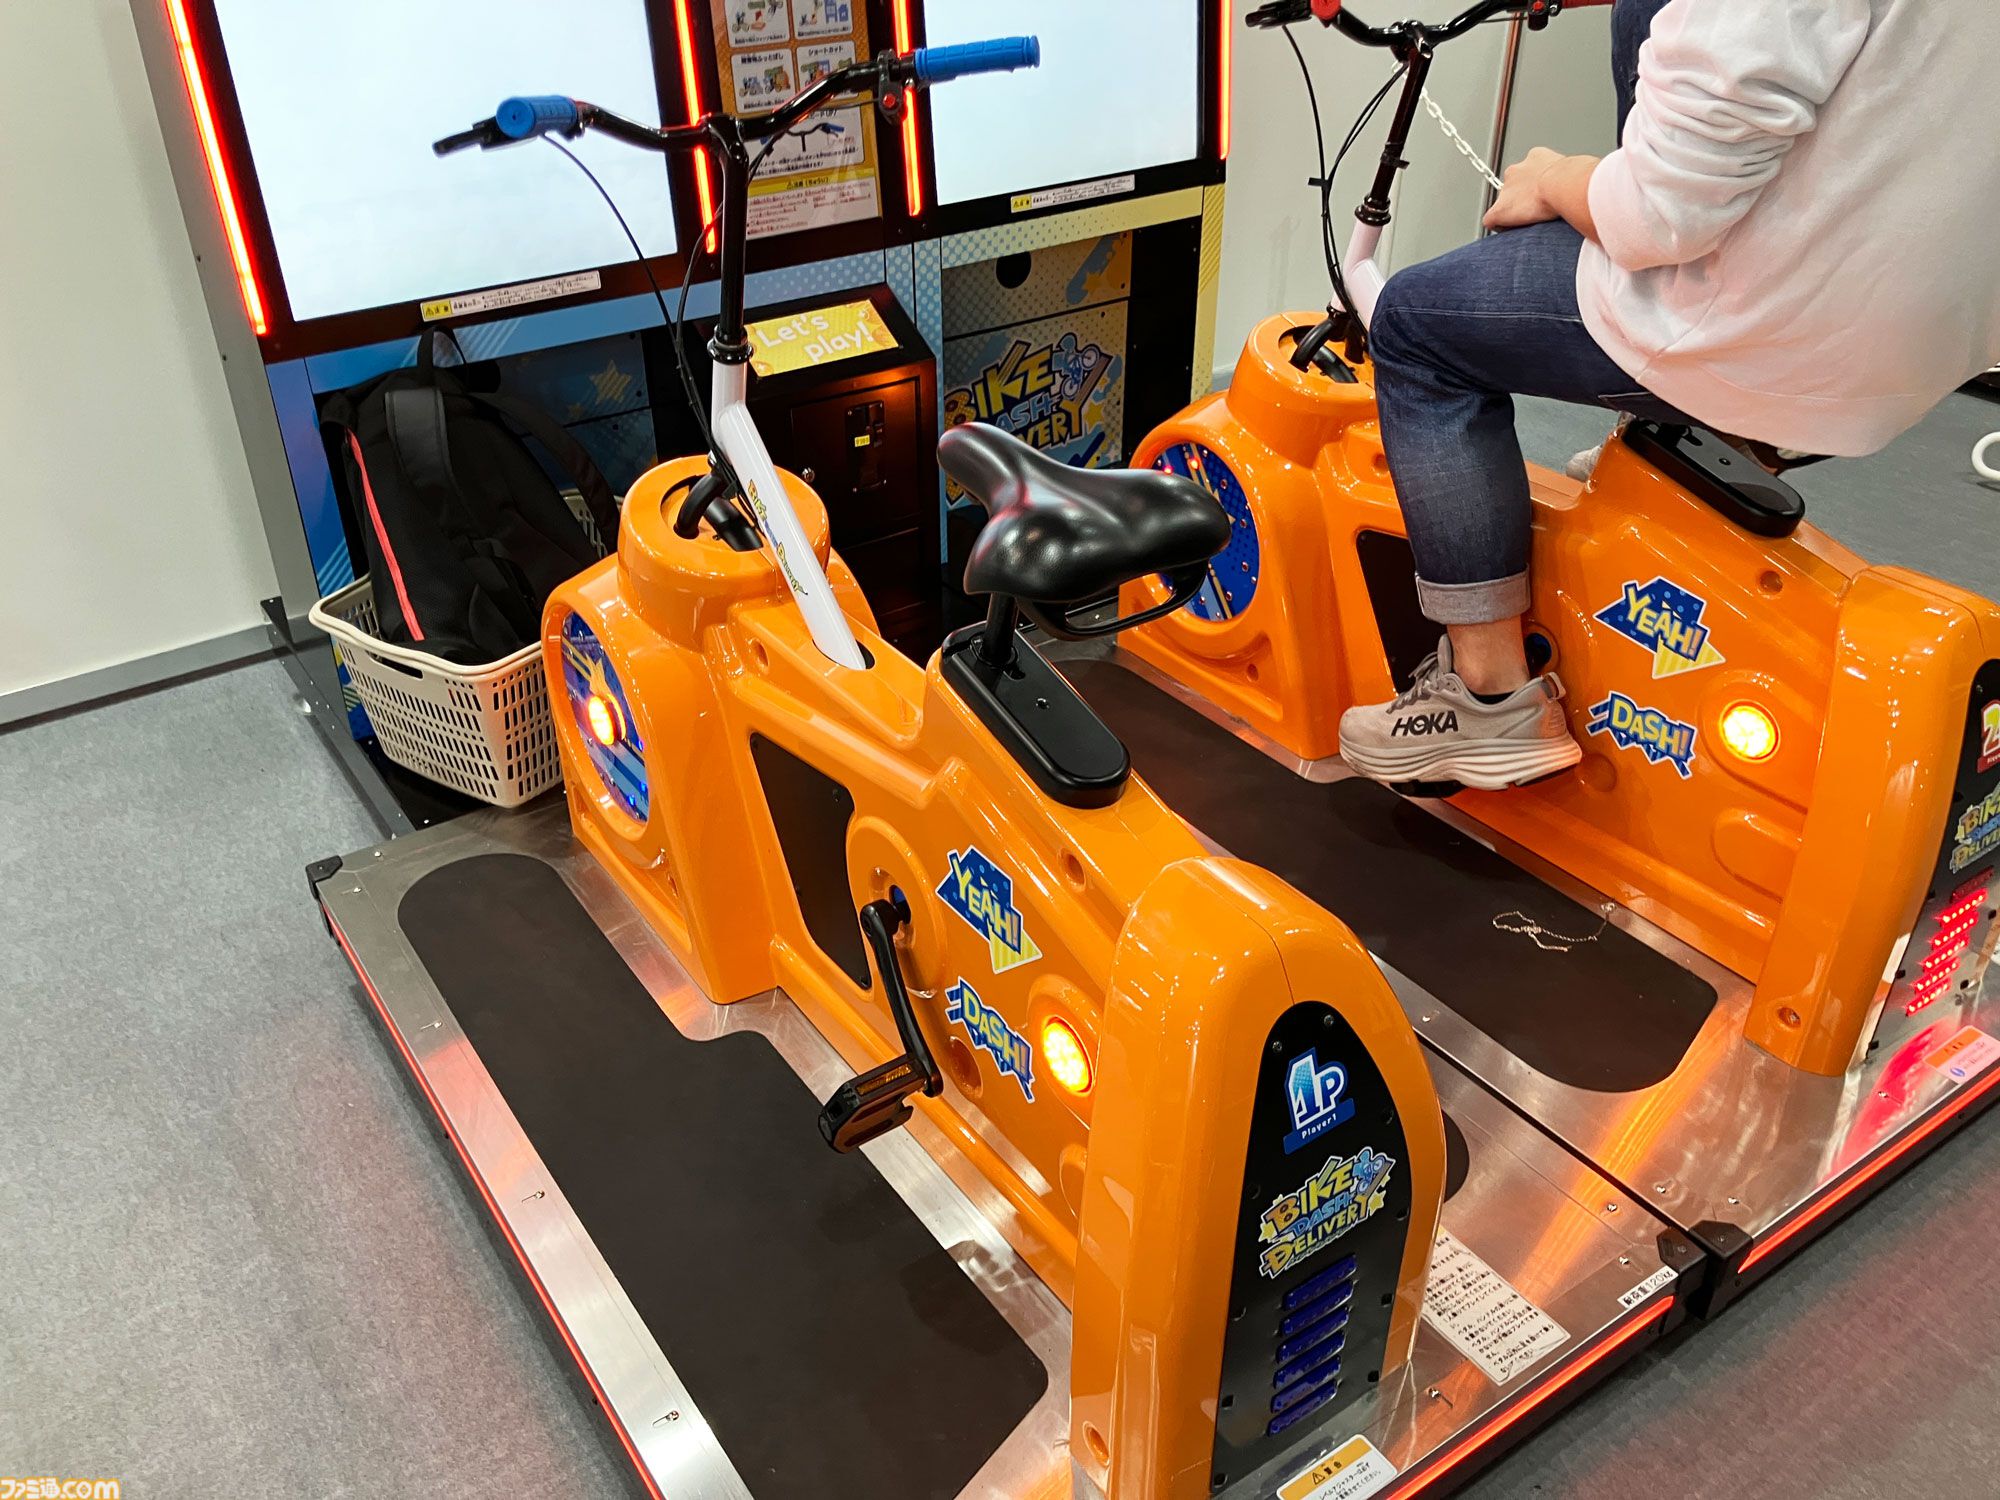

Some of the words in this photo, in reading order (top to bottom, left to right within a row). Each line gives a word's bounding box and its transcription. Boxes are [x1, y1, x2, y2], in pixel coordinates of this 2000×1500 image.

[756, 313, 829, 348] Let's
[804, 320, 875, 364] play!
[944, 341, 1054, 426] BIKE
[995, 392, 1054, 433] ASH
[1626, 585, 1703, 658] YEAH!
[1391, 710, 1458, 737] HOKA
[1610, 698, 1691, 756] DASH!
[951, 857, 1019, 950] YEAH!
[962, 985, 1029, 1078] DASH!
[1289, 1054, 1345, 1130] 1P
[1302, 1113, 1337, 1139] Player1
[1262, 1162, 1393, 1274] DELIVERY
[1264, 1158, 1355, 1233] BIKE
[1284, 1190, 1353, 1237] DASH
